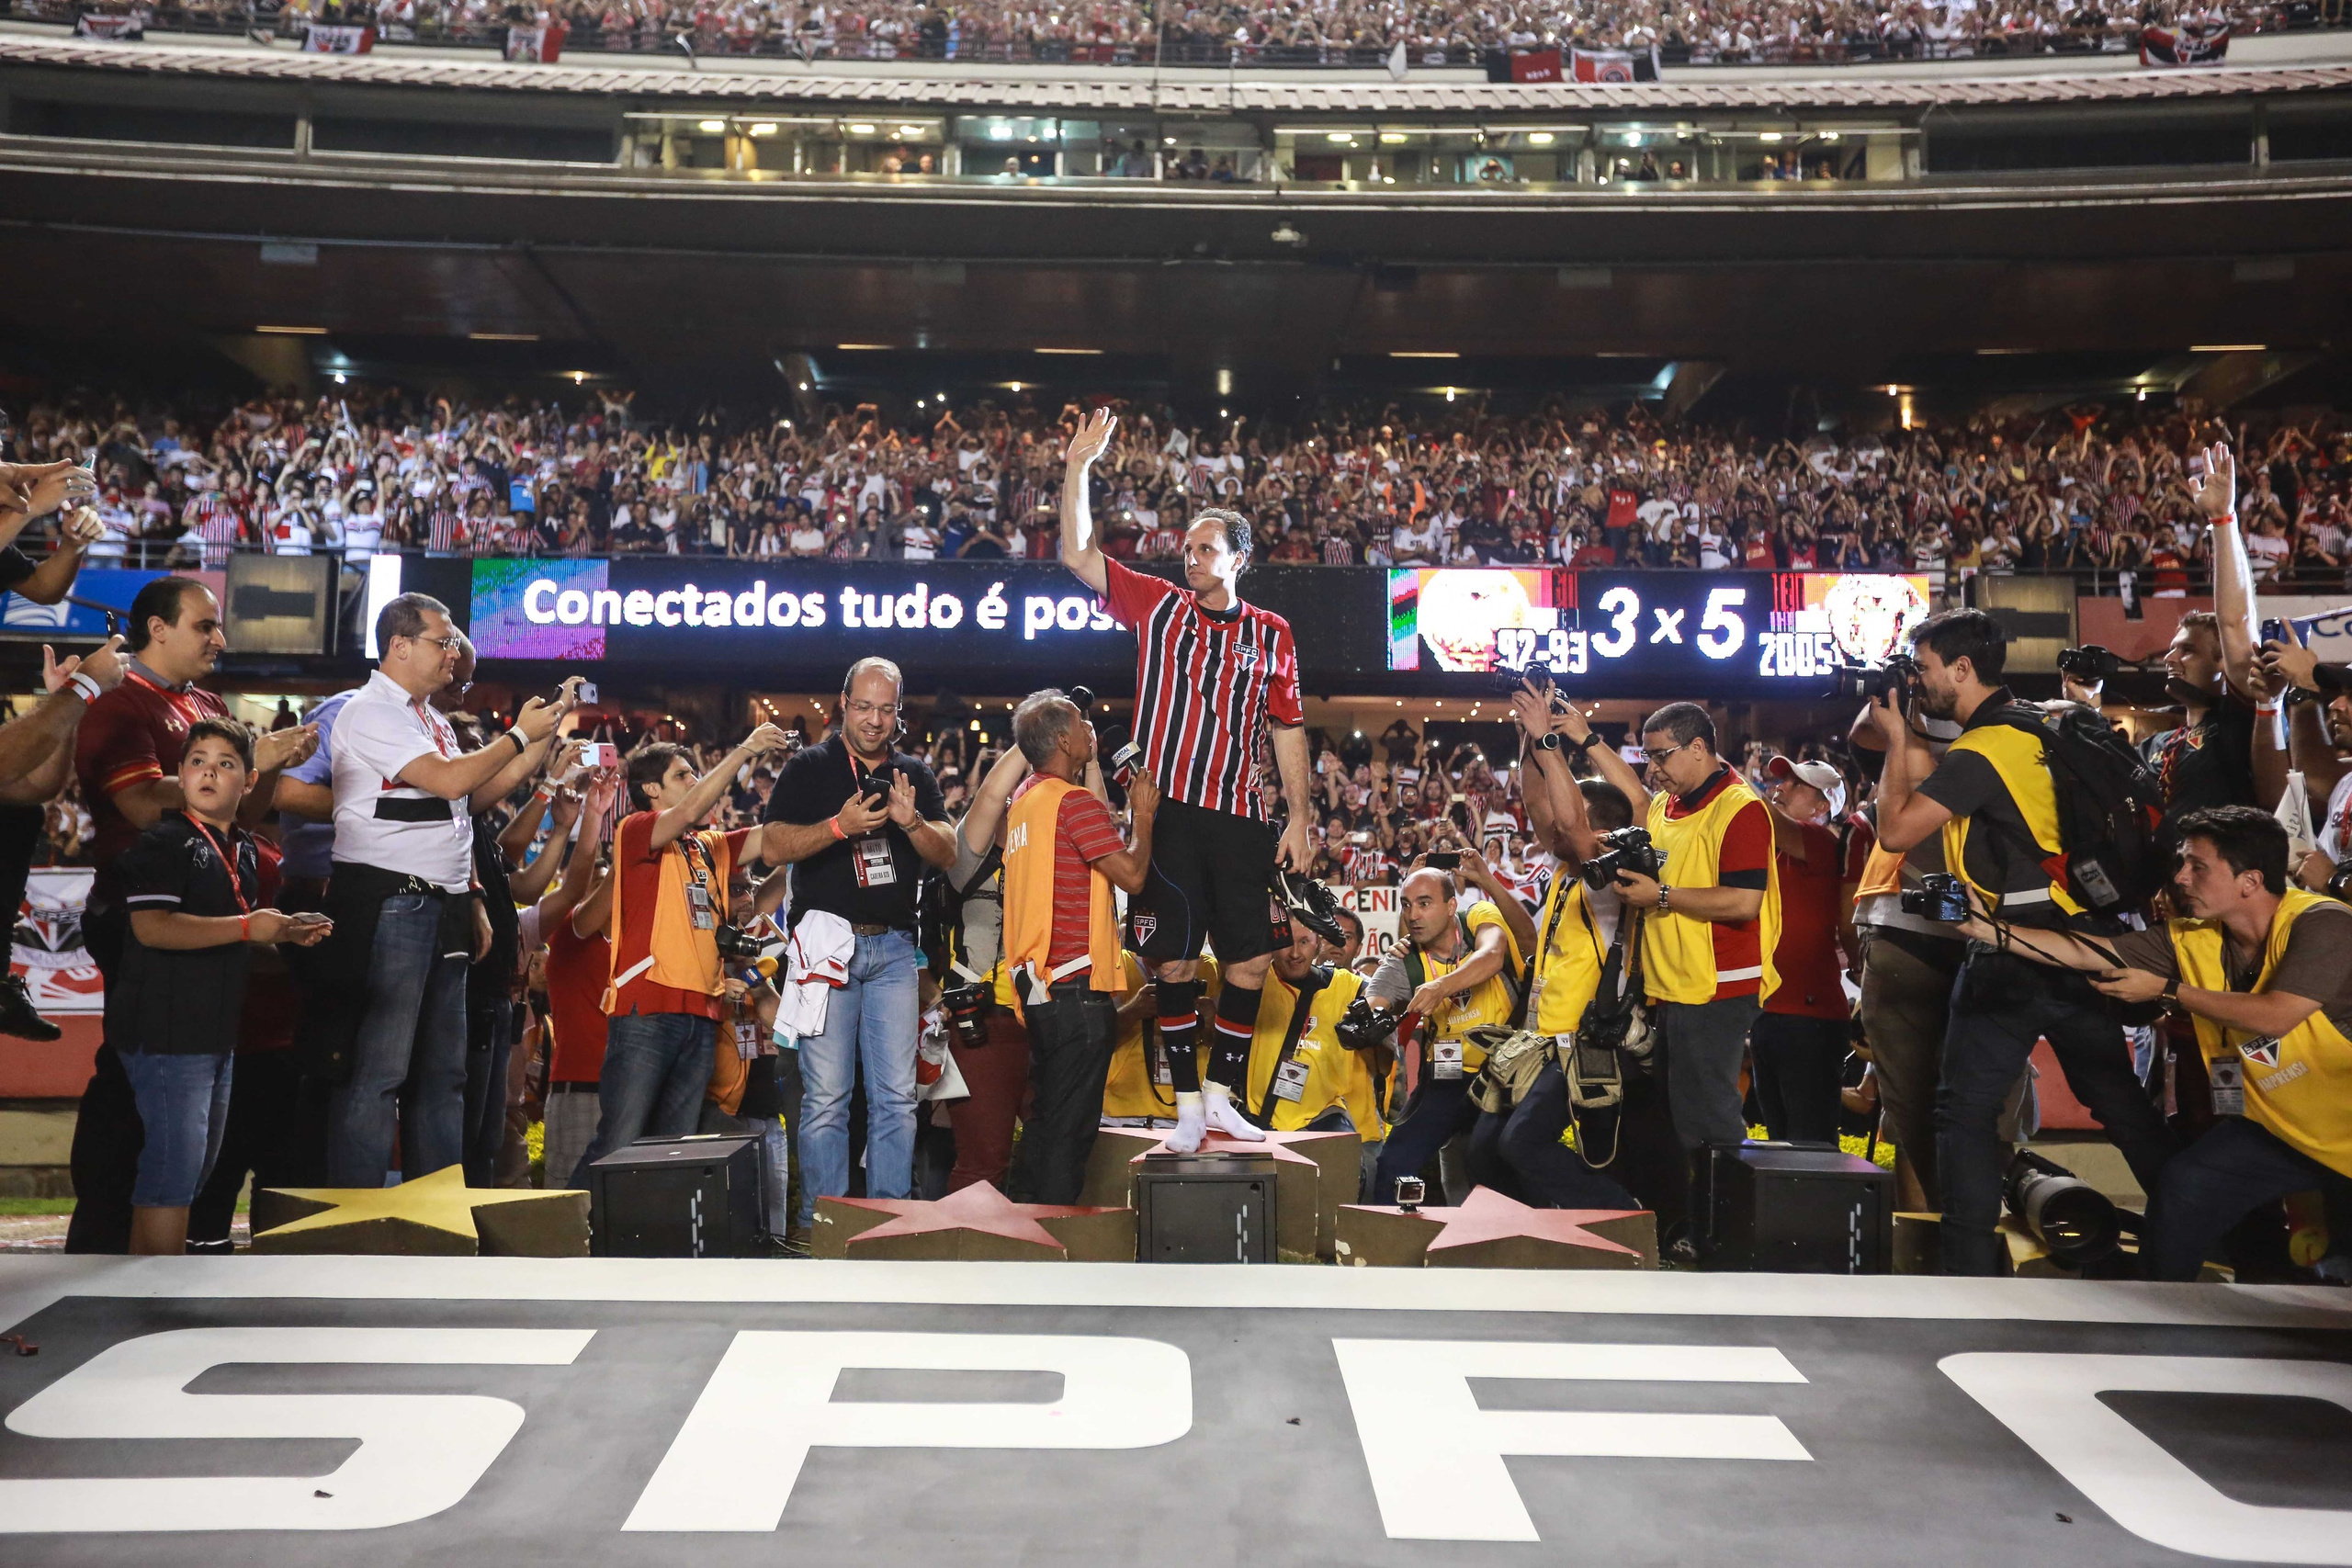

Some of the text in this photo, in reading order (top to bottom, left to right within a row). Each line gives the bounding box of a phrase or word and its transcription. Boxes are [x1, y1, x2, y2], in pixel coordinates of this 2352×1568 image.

[523, 579, 1127, 640] Conectados tudo é pos
[1590, 586, 1640, 659] 3
[1696, 588, 1747, 660] 5
[1233, 643, 1258, 657] SPFC
[1496, 628, 1589, 674] 92-93
[1758, 631, 1835, 678] 2005
[1114, 747, 1131, 761] CAPITAL
[1341, 889, 1396, 912] CENI
[1136, 918, 1154, 927] SPFC
[1447, 1008, 1482, 1025] IMPRENSA
[2256, 1060, 2310, 1093] IMPRENSA
